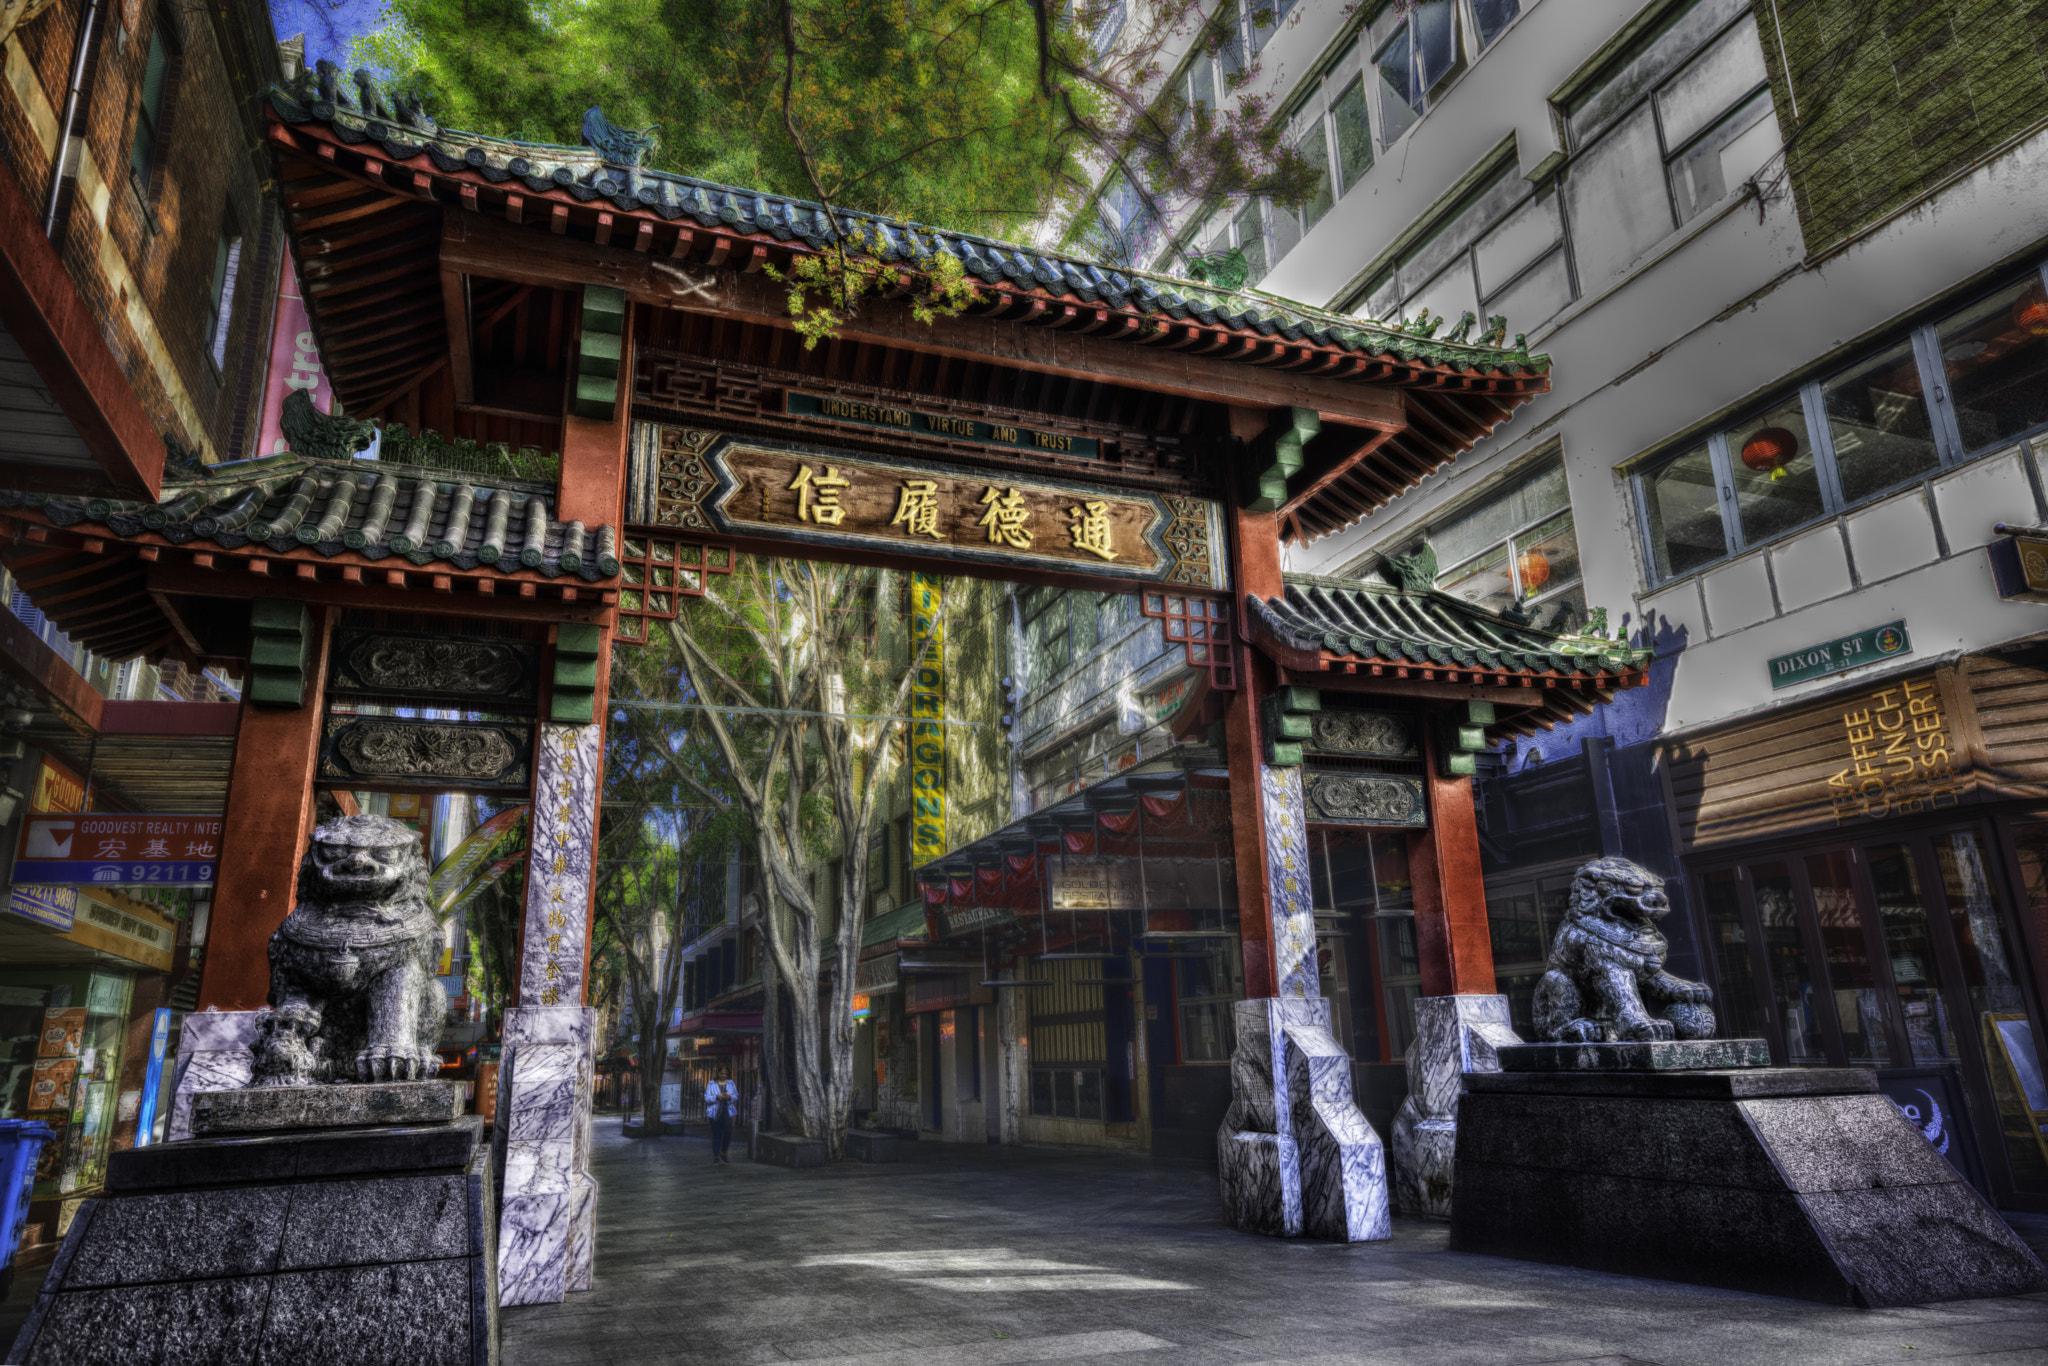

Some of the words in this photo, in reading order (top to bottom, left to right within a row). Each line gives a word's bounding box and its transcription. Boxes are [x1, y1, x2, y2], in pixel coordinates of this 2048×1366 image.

[821, 399, 911, 427] UNDERSTAND
[928, 415, 974, 437] VIRTUE
[992, 426, 1017, 443] AND
[1034, 431, 1073, 451] TRUST
[1776, 646, 1832, 675] DIXON
[1841, 637, 1864, 657] ST
[1158, 677, 1185, 707] NEW
[914, 668, 942, 846] DRAGONS
[1843, 707, 1891, 820] COFFEE
[1871, 687, 1925, 816] BRUNCH
[1903, 680, 1959, 811] DESSERT
[1828, 767, 1859, 827] TEA
[81, 820, 143, 834] GOODVEST
[146, 822, 189, 834] REALTY
[131, 865, 189, 881] 9211
[1062, 880, 1117, 889] GOLDEN
